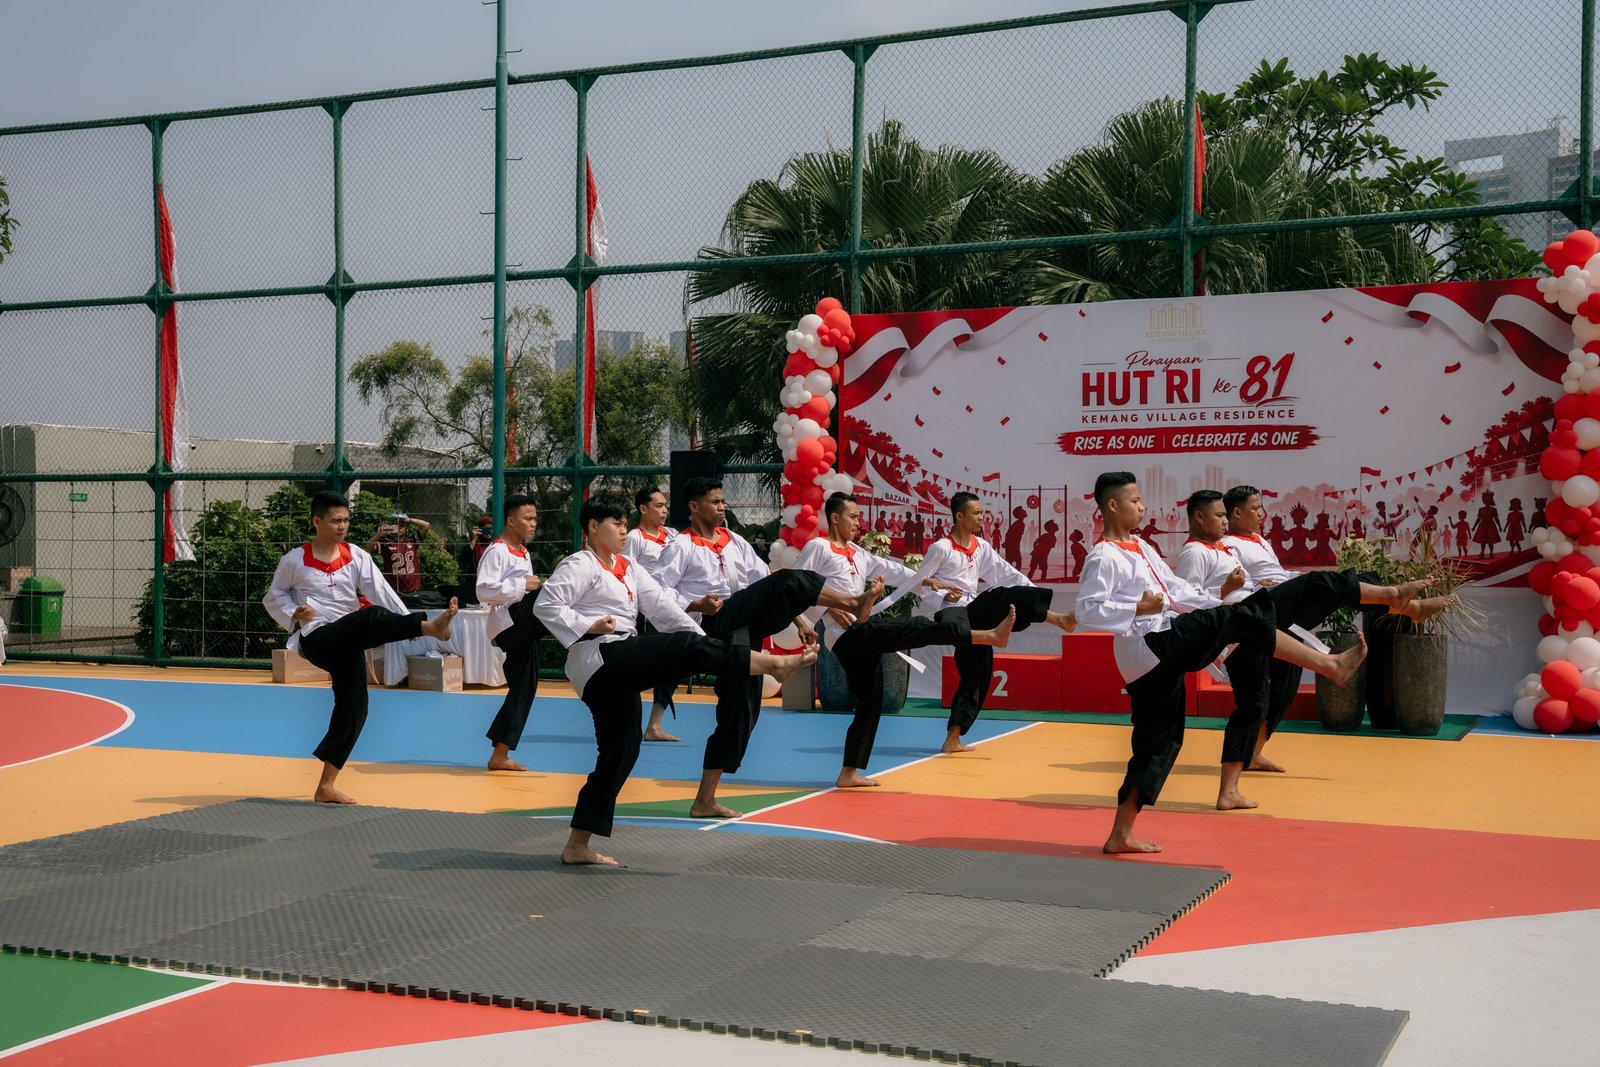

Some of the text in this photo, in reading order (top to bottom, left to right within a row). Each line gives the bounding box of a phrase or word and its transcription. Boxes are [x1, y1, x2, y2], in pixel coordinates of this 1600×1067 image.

[1125, 350, 1203, 372] Perayaan
[1082, 370, 1154, 406] HUT
[1166, 368, 1201, 404] RI
[1081, 409, 1296, 424] KEMANG VILLAGE RESIDENCE
[1073, 431, 1300, 451] RISE AS ONE CELEBRATE AS ONE
[884, 492, 910, 504] BAZAAR
[991, 670, 1008, 697] 2
